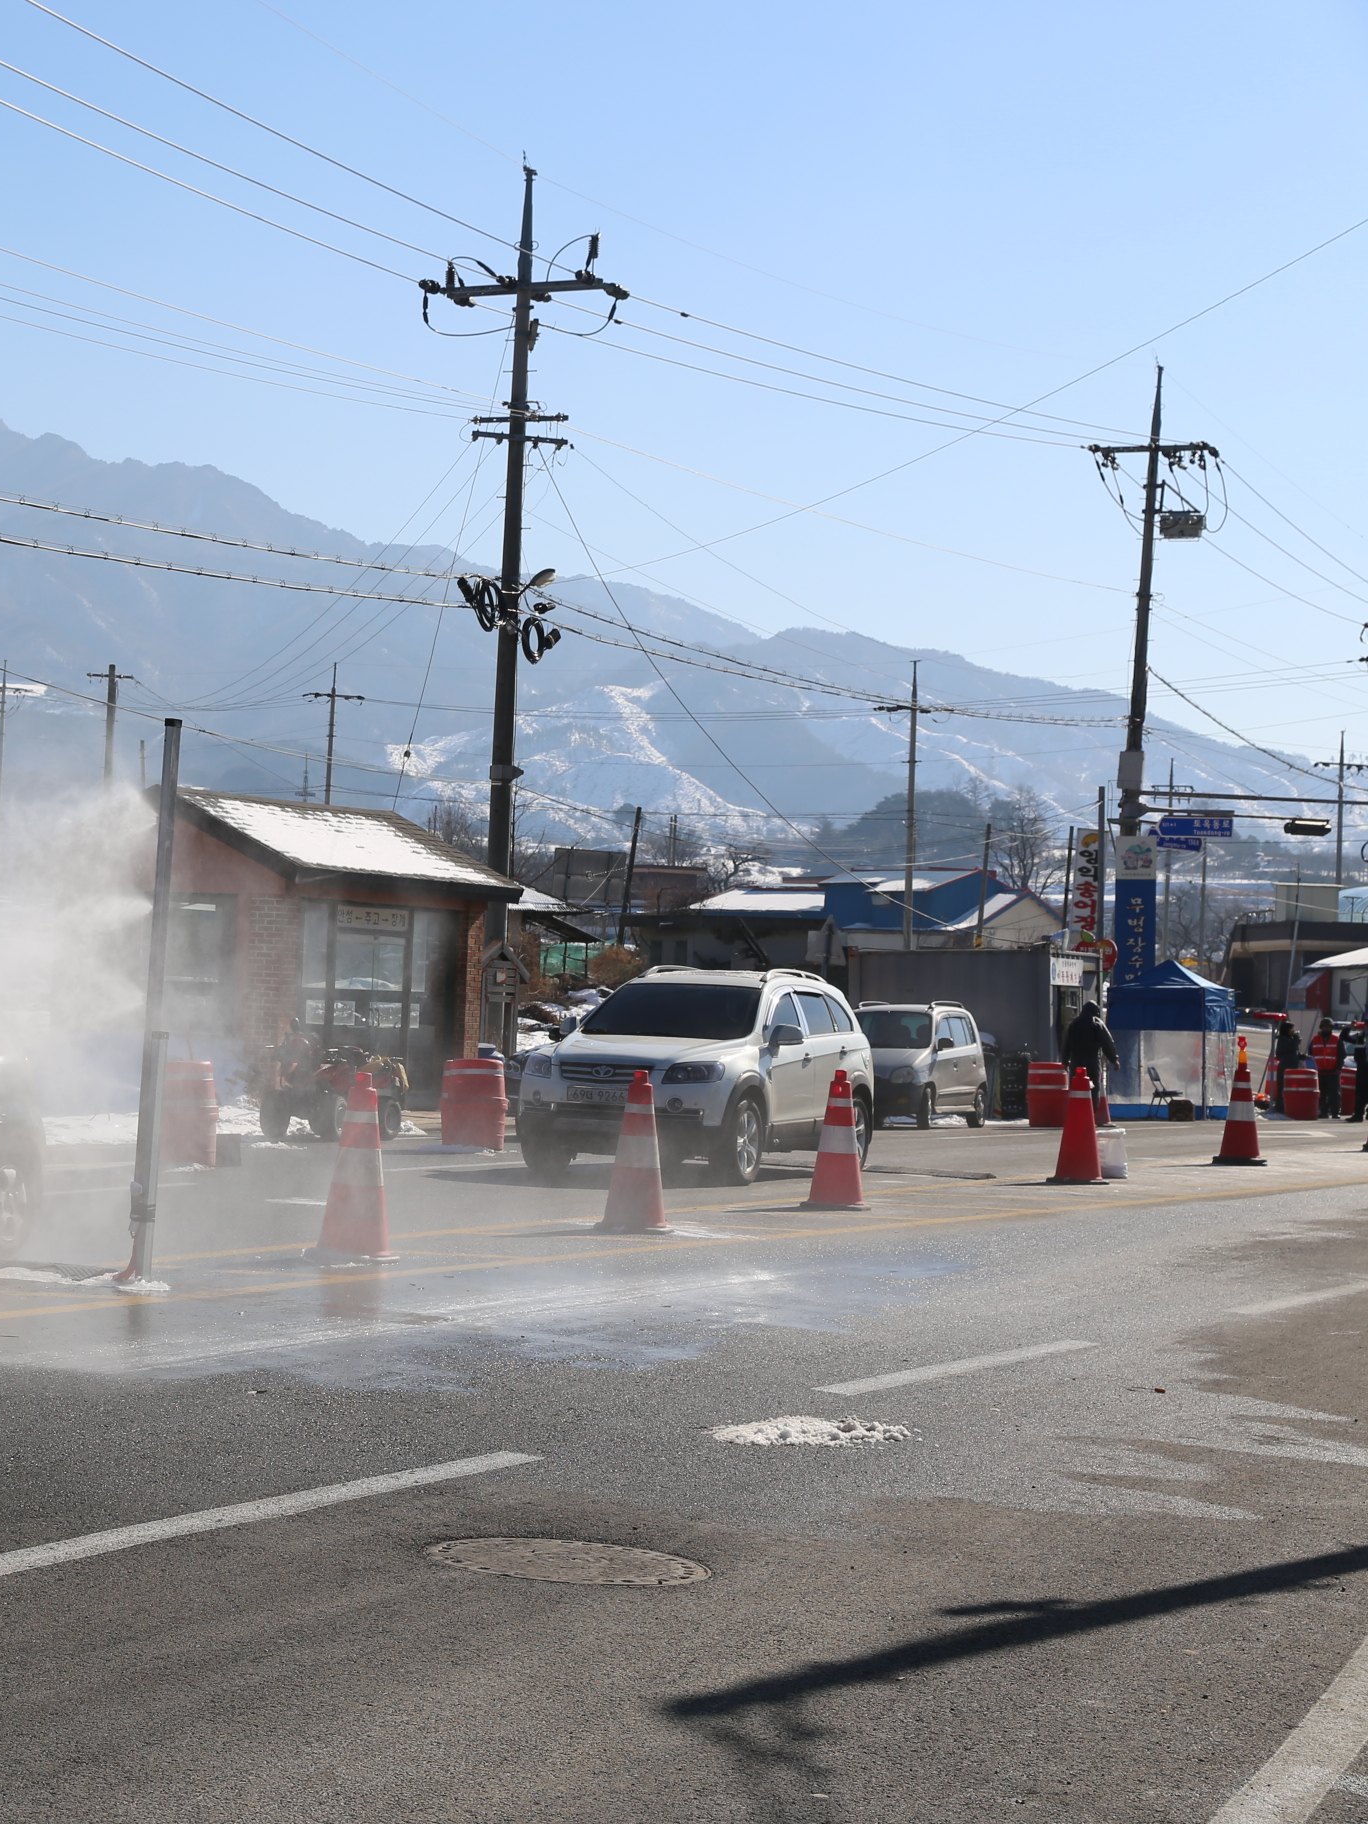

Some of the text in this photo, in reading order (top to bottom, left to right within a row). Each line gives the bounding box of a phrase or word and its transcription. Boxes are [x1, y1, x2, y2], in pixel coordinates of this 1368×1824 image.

[1193, 819, 1230, 829] 토옥동로
[338, 909, 353, 924] 안성
[365, 911, 379, 925] 주고
[597, 1091, 625, 1102] 9266
